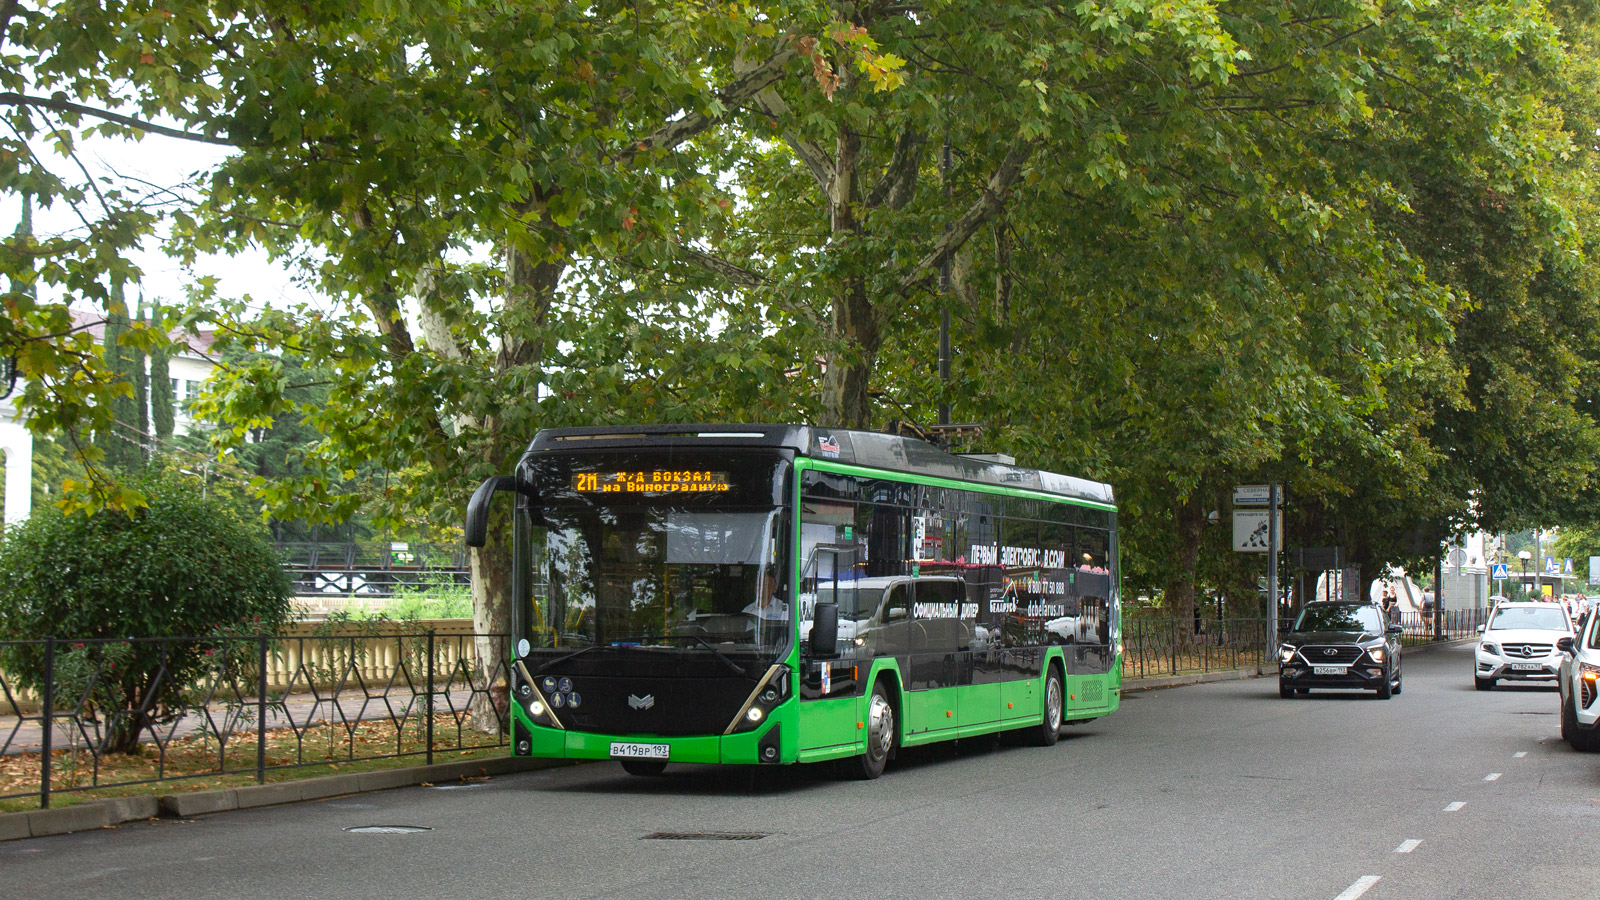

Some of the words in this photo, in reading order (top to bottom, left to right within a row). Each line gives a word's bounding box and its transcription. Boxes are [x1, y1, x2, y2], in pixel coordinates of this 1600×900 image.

[616, 471, 645, 483] Ж/Д
[653, 470, 711, 482] ВОКЗАЛ
[602, 483, 621, 492] на
[626, 481, 728, 492] Виноградную
[971, 541, 998, 565] ПЕРВЫЙ
[1043, 549, 1049, 568] В
[1049, 550, 1065, 569] СОЧИ
[1032, 582, 1041, 594] 800
[1043, 582, 1049, 594] 77
[1049, 582, 1055, 594] 50
[1056, 582, 1065, 595] 888
[913, 600, 959, 620] ОФИЦИАЛЬНЫЙ
[960, 602, 979, 620] ДИЛЕР
[1027, 599, 1065, 617] dcbelarus.ru
[613, 744, 650, 756] В419ВР
[652, 745, 667, 754] 193
